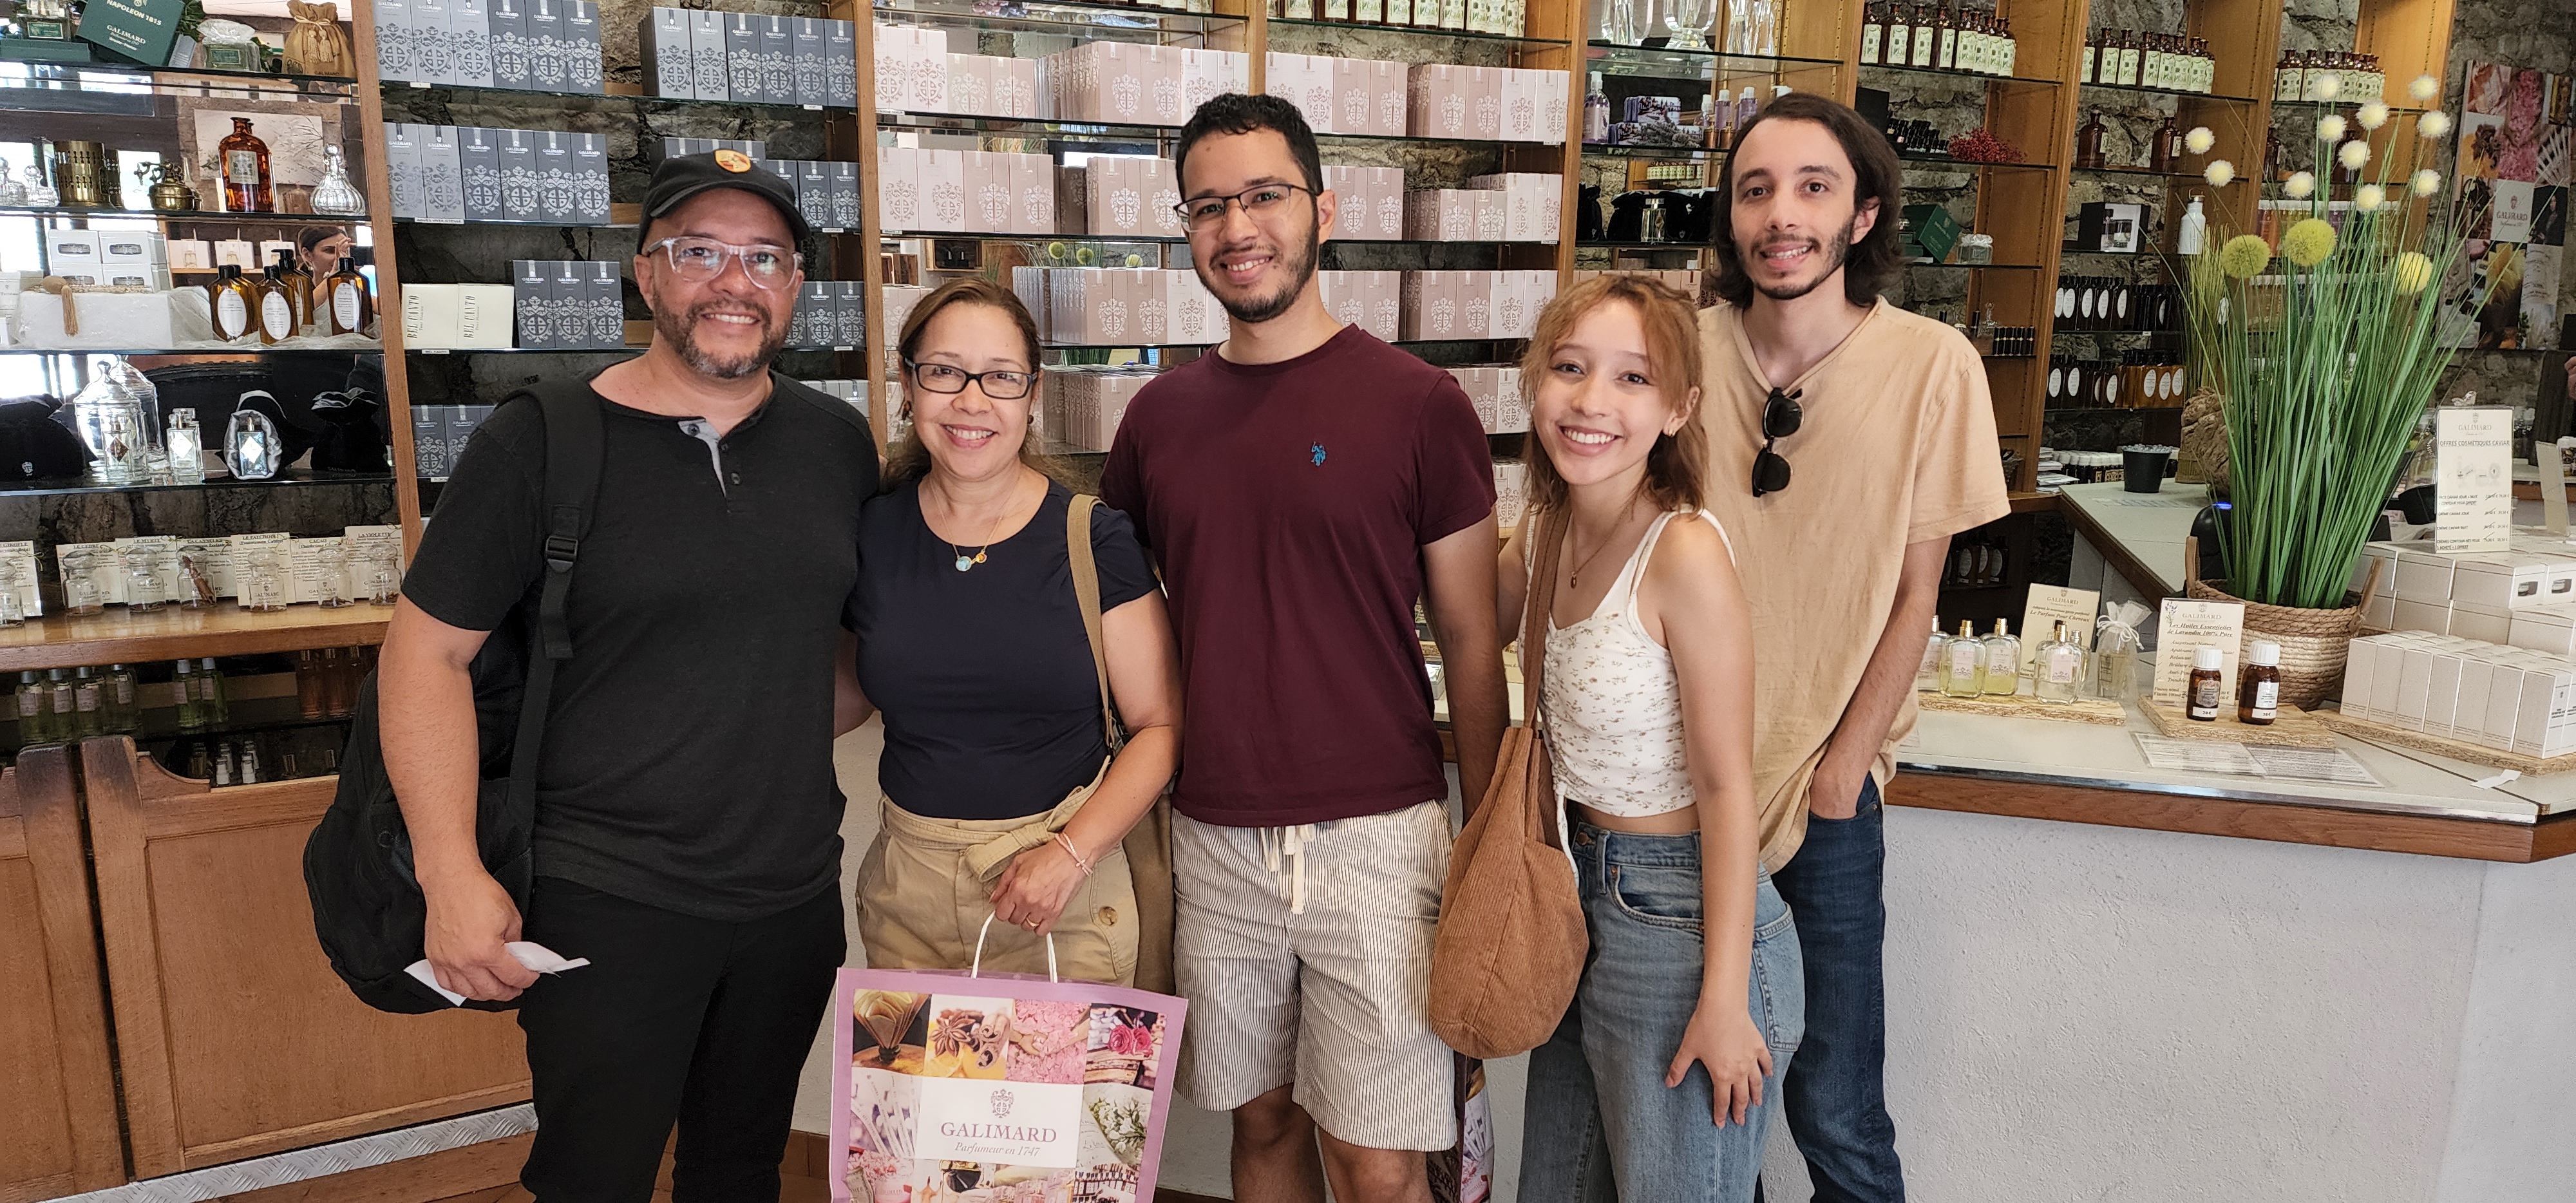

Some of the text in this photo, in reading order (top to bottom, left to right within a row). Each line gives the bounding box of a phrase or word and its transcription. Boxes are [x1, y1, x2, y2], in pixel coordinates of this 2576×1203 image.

[106, 0, 162, 26] NAPOLEON 1815
[106, 24, 146, 44] GALIMARD
[407, 295, 419, 339] BEL CANTO
[463, 296, 475, 339] BEL CANTO
[2047, 596, 2079, 605] GALIMARD
[2069, 614, 2090, 623] Cheveux
[940, 1122, 1057, 1142] GALIMARD
[954, 1142, 1004, 1154] Parfumeur
[1018, 1146, 1041, 1157] 1747
